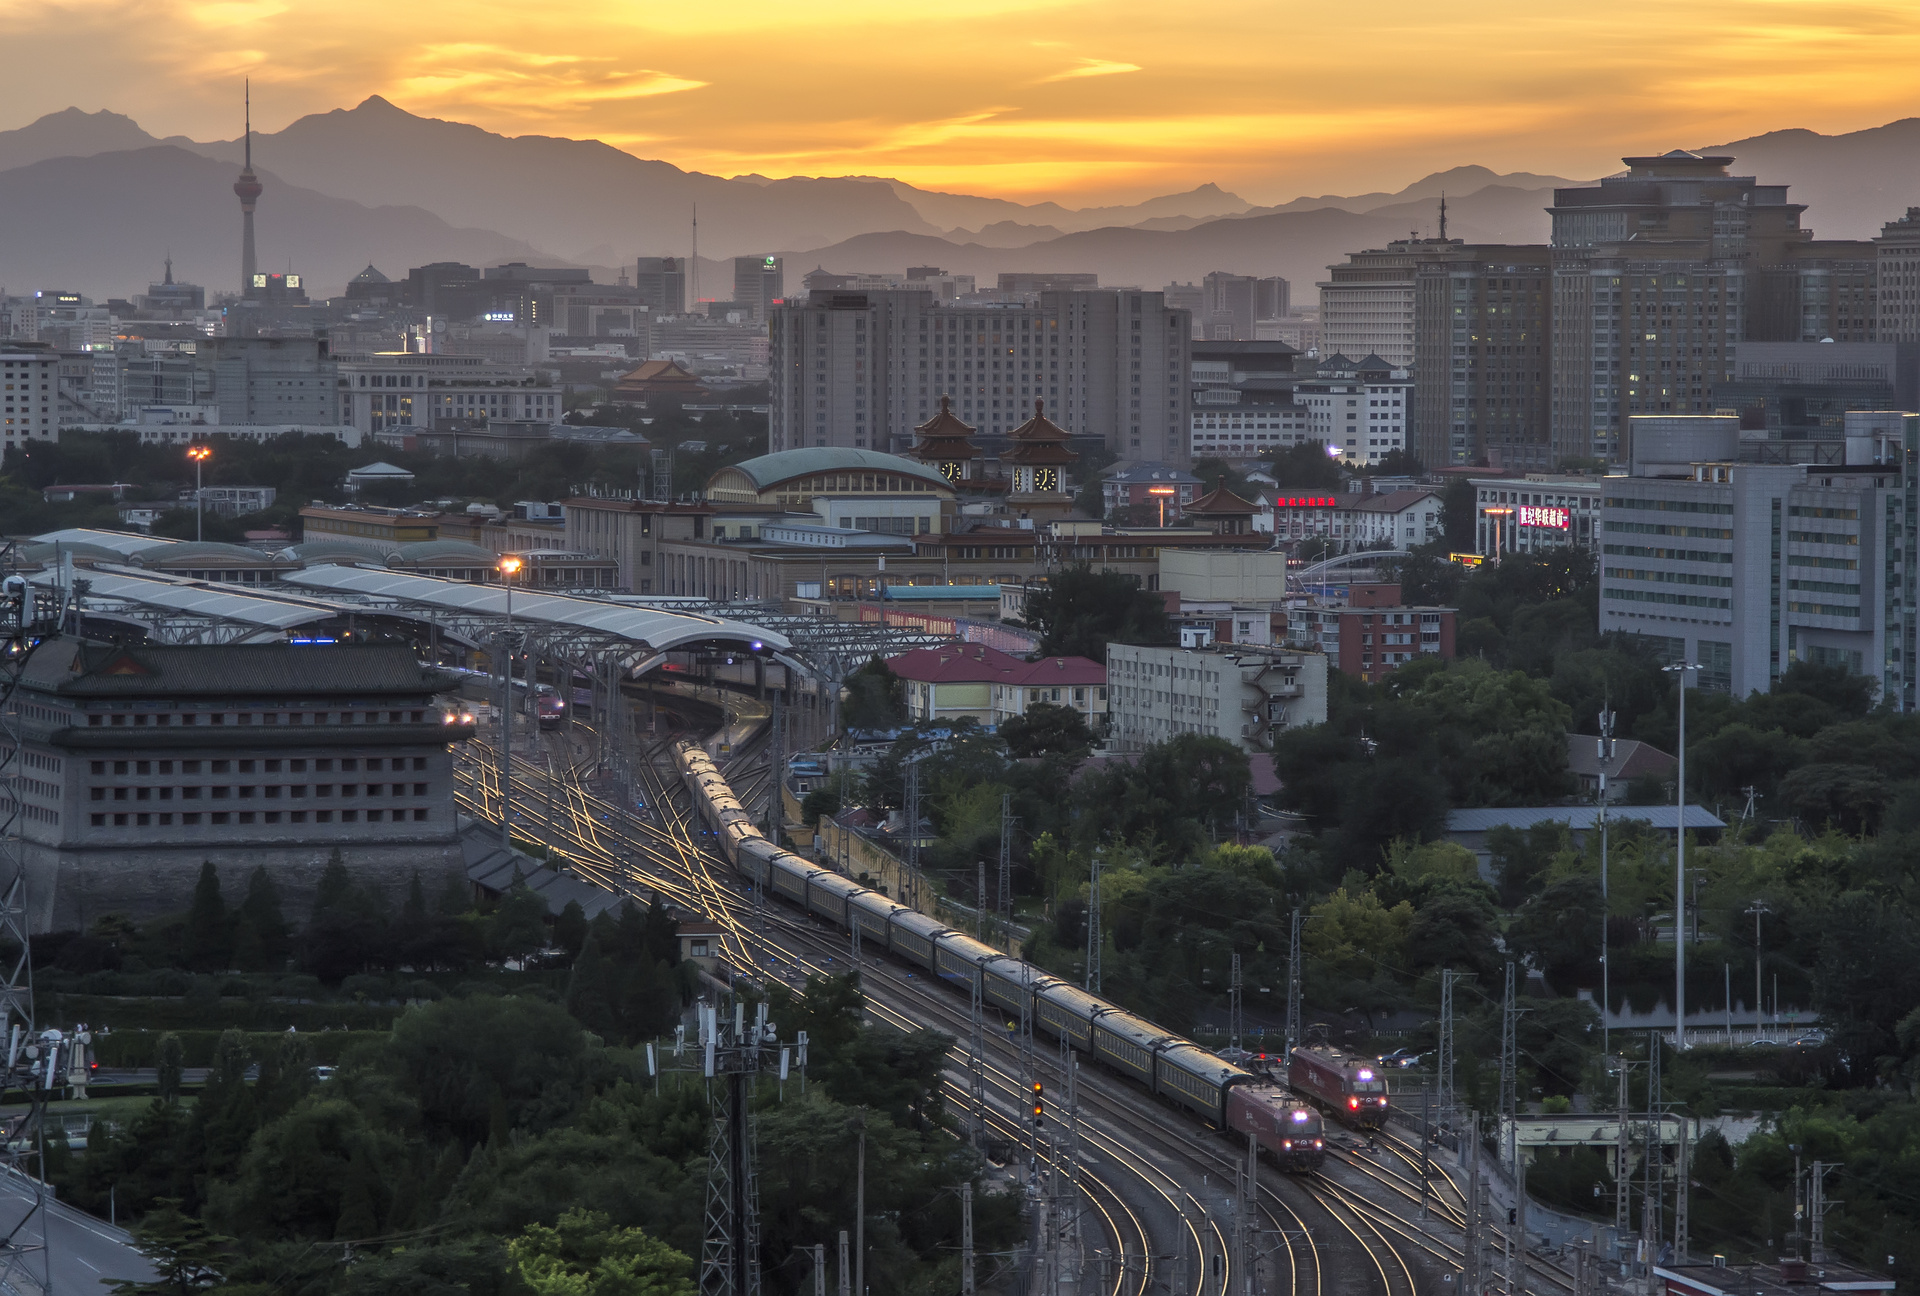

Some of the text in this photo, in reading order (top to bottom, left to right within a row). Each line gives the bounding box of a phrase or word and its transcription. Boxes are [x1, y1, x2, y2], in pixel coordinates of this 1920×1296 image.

[1520, 507, 1564, 527] 世纪华联超市
